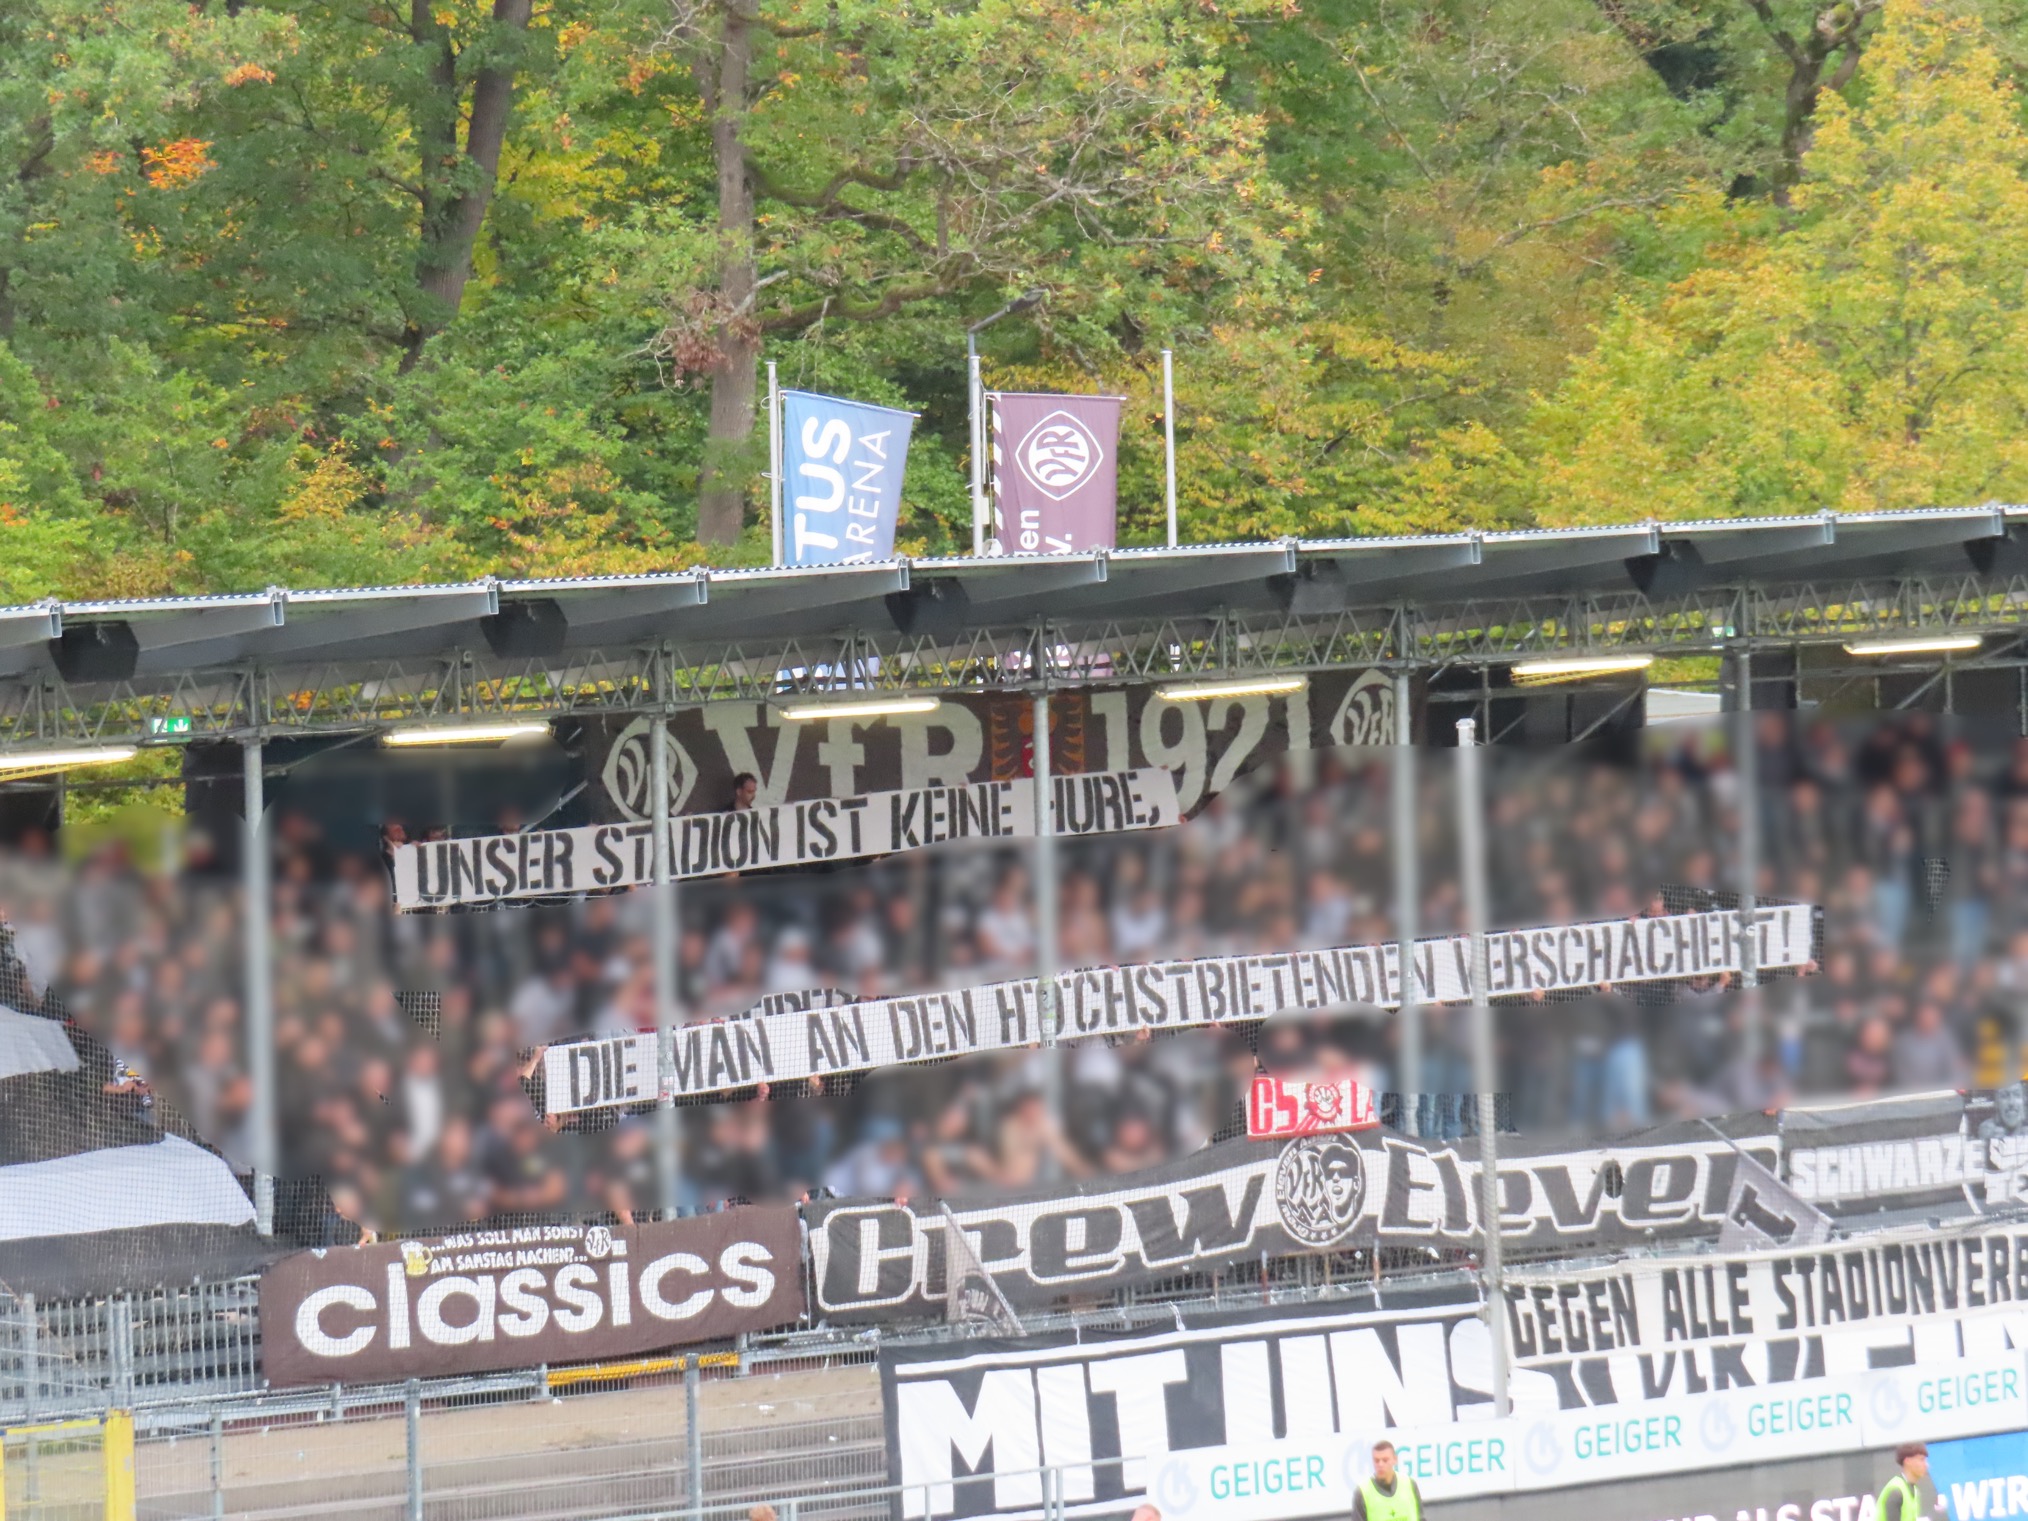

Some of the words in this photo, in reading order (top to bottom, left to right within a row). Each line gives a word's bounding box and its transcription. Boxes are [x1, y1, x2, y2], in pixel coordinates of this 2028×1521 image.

[794, 416, 851, 560] TUS
[843, 429, 891, 562] ARENA
[702, 700, 982, 805] VfR
[417, 832, 574, 903] UNSER
[592, 807, 779, 886] STADION
[795, 797, 868, 859] IST
[890, 782, 1013, 850] KEINE
[569, 1039, 638, 1108] DIE
[672, 1018, 774, 1092] MAN
[806, 1004, 870, 1073] AN
[887, 989, 977, 1060] DEN
[995, 943, 1436, 1045] HÖCHSTBIETENDEN
[1453, 910, 1790, 995] VERSCHACHERT!
[1789, 1136, 1985, 1199] SCHWARZE
[431, 1256, 454, 1275] AM
[457, 1250, 514, 1271] SAMSTAG
[477, 1230, 511, 1246] SOLL
[512, 1227, 542, 1244] MAN
[818, 1172, 1269, 1310] Crew
[1380, 1138, 1779, 1236] Eleven
[296, 1239, 775, 1357] classics
[1505, 1272, 1641, 1358] GEGEN
[1661, 1262, 1754, 1343] ALLE
[897, 1348, 1188, 1519] MIT
[1574, 1414, 1682, 1459] GEIGER
[1748, 1392, 1853, 1437] GEIGER
[1916, 1367, 2019, 1414] GEIGER
[1209, 1453, 1326, 1502] GEIGER
[1394, 1437, 1505, 1478] GEIGER
